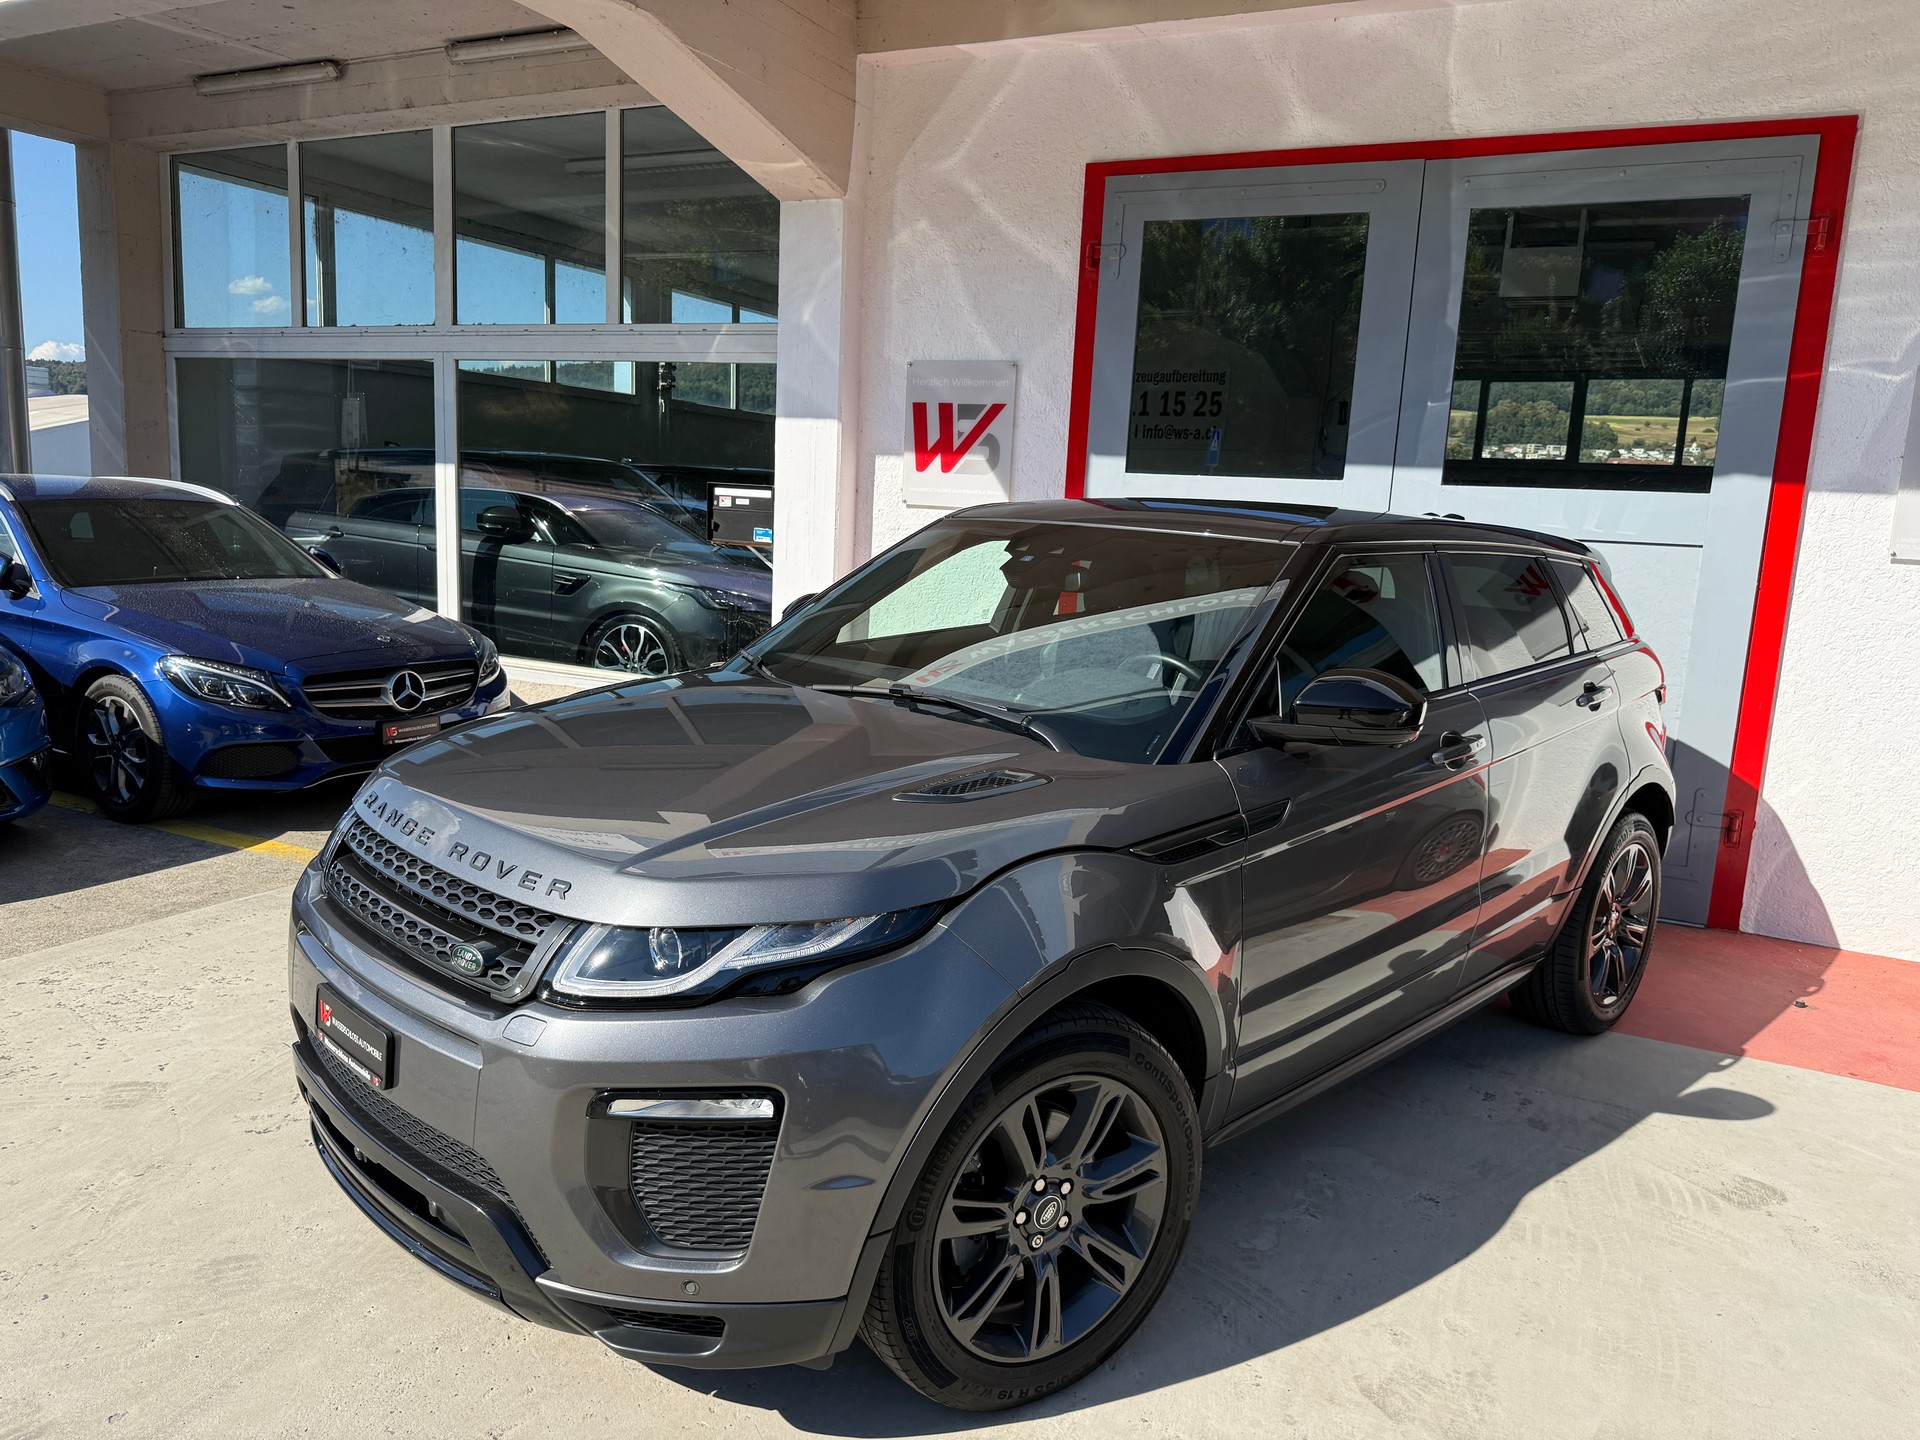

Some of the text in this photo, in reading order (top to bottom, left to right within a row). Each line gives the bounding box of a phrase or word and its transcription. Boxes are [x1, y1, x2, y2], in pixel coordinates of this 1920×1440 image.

[912, 377, 1010, 388] Herzlich Willkommen
[1135, 369, 1227, 386] zeugaufbereitung
[1159, 390, 1186, 417] 15
[1192, 390, 1223, 418] 25
[363, 790, 573, 901] RANGE ROVER
[456, 948, 474, 961] LAND
[457, 957, 477, 971] ROVER
[997, 1389, 1014, 1400] 19
